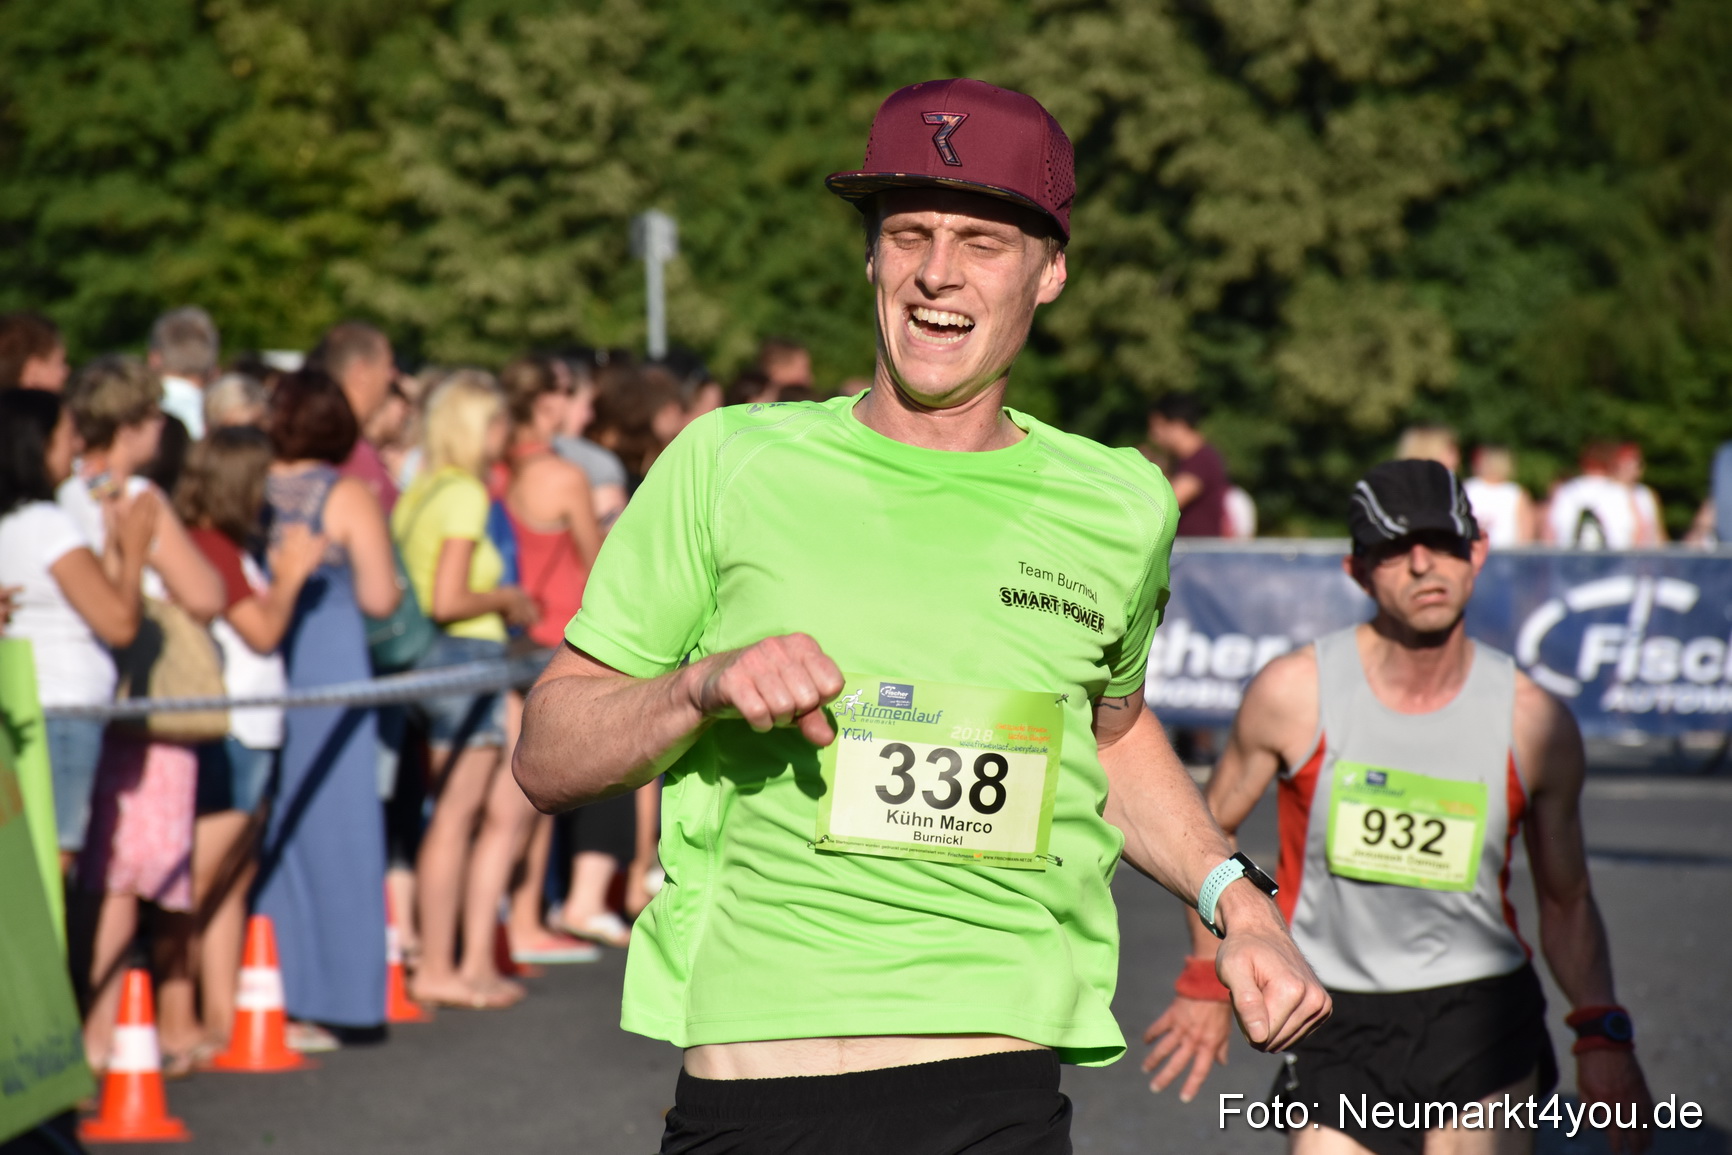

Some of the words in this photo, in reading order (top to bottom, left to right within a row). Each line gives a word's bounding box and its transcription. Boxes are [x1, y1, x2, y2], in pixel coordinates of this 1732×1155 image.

[1018, 561, 1054, 583] Team
[1000, 587, 1061, 616] SMART
[1062, 599, 1105, 635] POWER
[861, 702, 944, 725] firmenlauf
[861, 717, 896, 726] neumarkt
[950, 726, 994, 743] 2018
[875, 742, 1009, 815] 338
[886, 809, 934, 828] Kühn
[940, 815, 993, 834] Marco
[1362, 807, 1447, 856] 932
[913, 831, 963, 846] Burnickl
